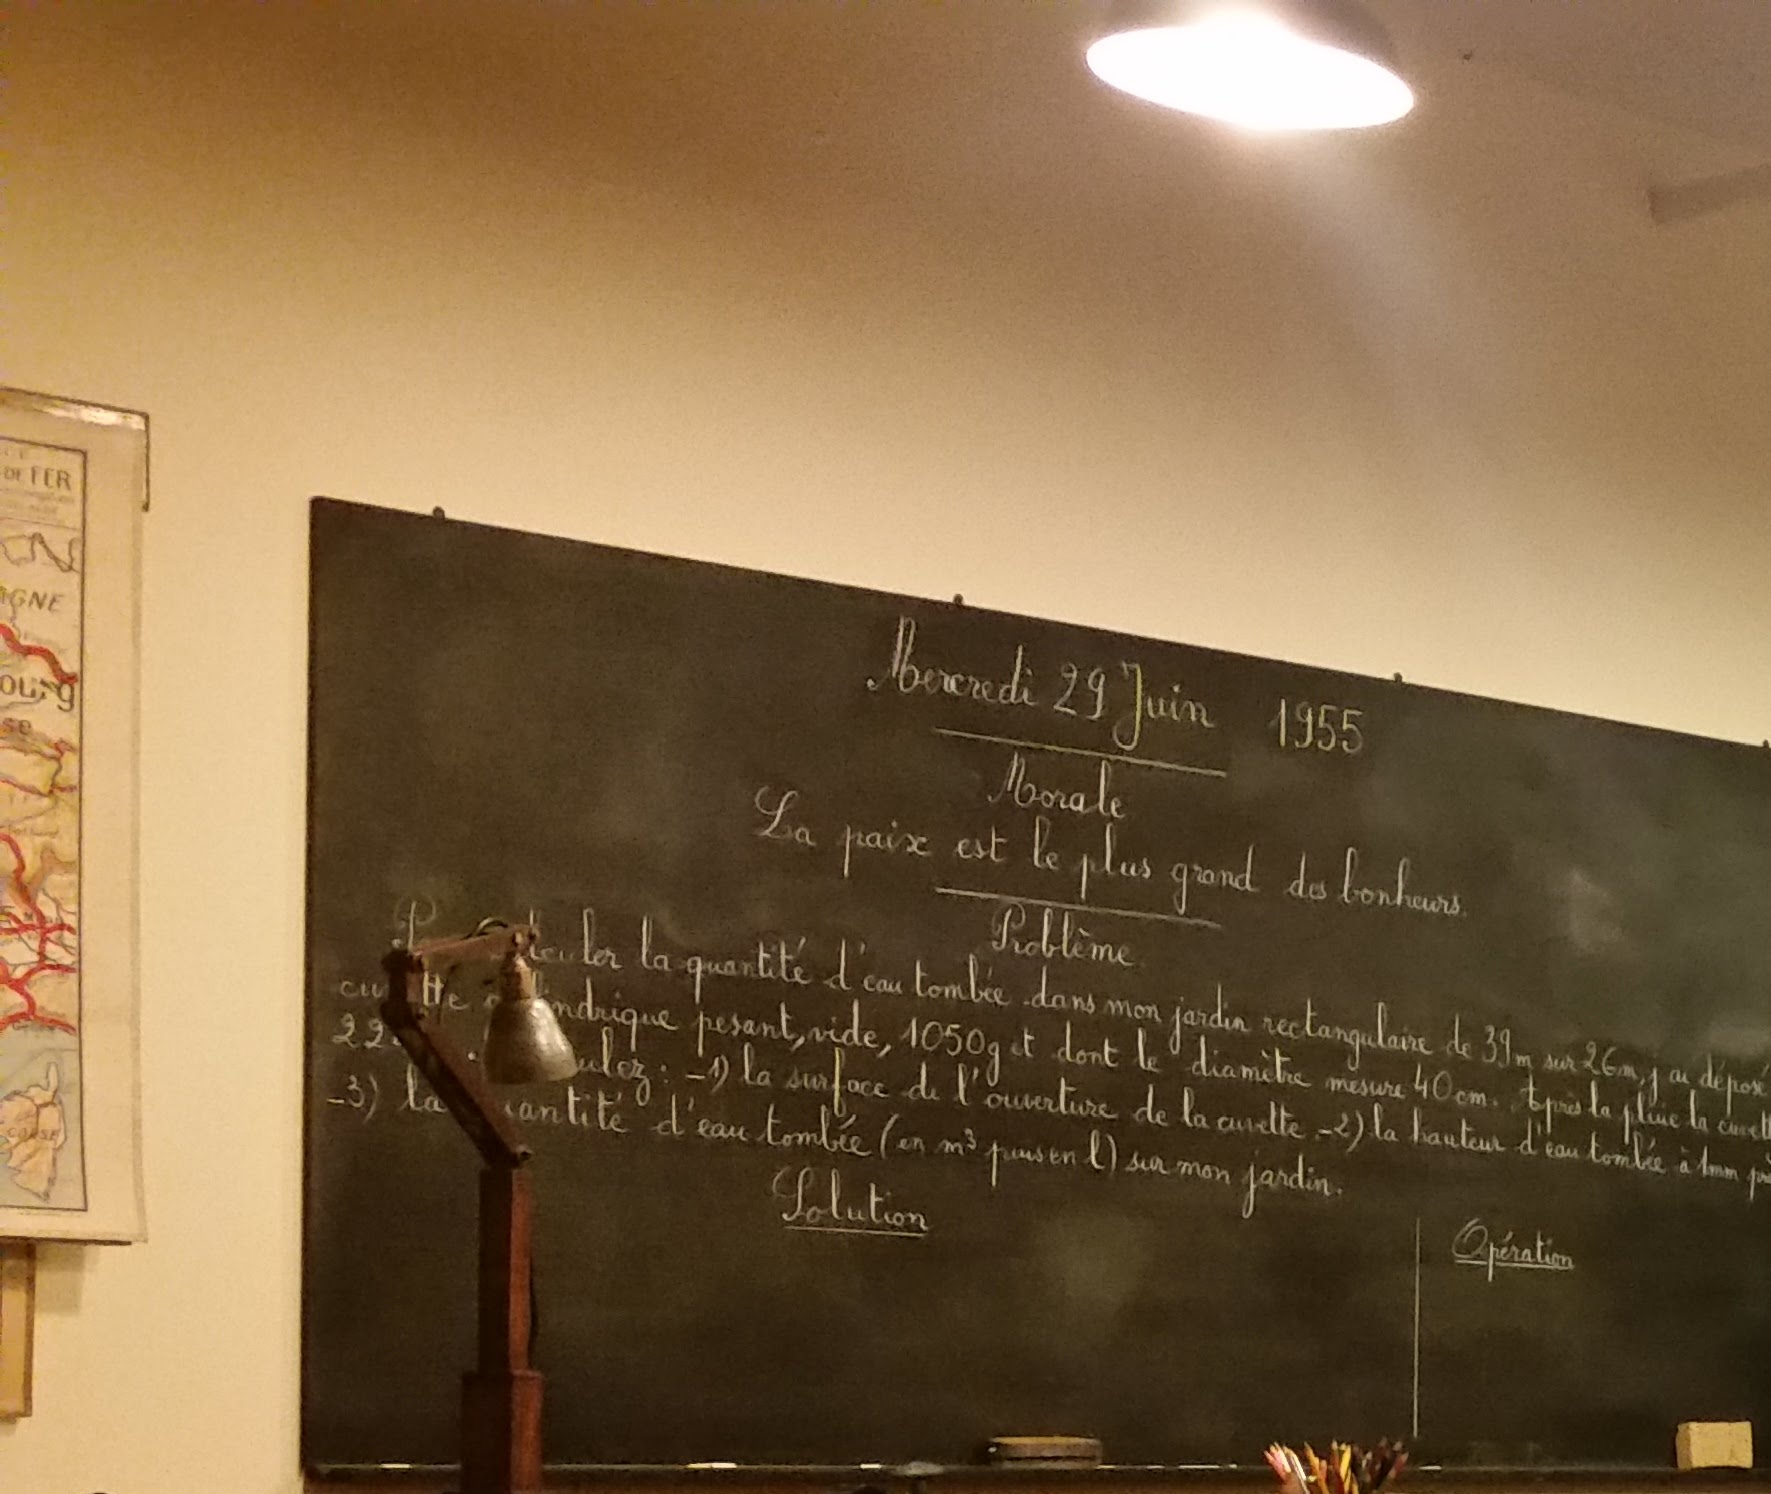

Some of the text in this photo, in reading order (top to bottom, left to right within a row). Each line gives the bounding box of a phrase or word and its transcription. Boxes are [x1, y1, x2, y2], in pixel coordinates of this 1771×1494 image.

[866, 616, 1364, 755] Mercredi 29 Juin 1955
[988, 752, 1126, 818] Morale
[754, 785, 818, 846] La
[840, 821, 931, 878] paix
[957, 826, 1006, 862] est
[1034, 815, 1060, 870] le
[1073, 823, 1151, 900] plus
[1169, 844, 1260, 915] grand
[1284, 852, 1328, 901] des
[641, 914, 673, 972] la
[686, 937, 812, 1004] quantité
[824, 938, 902, 995] d'eau
[915, 954, 1010, 1005] tombée
[1024, 965, 1096, 1013] dans
[1106, 998, 1161, 1024] mon
[1169, 983, 1249, 1055] jardin
[1263, 998, 1433, 1071] rectangulaire
[1447, 1013, 1472, 1059] de
[1543, 1053, 1577, 1073] sur
[402, 1062, 448, 1113] la
[653, 1094, 748, 1142] d'eau
[760, 1103, 873, 1157] tombée
[988, 1140, 1045, 1188] puis
[1050, 1148, 1077, 1166] en
[1125, 1151, 1169, 1176] sur
[1177, 1158, 1231, 1185] mon
[744, 1042, 771, 1087] la
[786, 1047, 890, 1117] surface
[909, 1061, 939, 1101] de
[1134, 1084, 1168, 1127] de
[1183, 1087, 1208, 1129] la
[1217, 1101, 1304, 1139] cuvette
[1374, 1102, 1398, 1142] la
[1412, 1106, 1505, 1151] hauteur
[1590, 1131, 1666, 1176] tombée
[1011, 1027, 1036, 1057] et
[1056, 1020, 1118, 1068] dont
[1135, 1027, 1162, 1073] le
[1189, 1035, 1311, 1087] diamètre
[1327, 1076, 1405, 1100] mesure
[1590, 1080, 1612, 1118] la
[1622, 1090, 1680, 1145] pluie
[1690, 1089, 1709, 1133] la
[772, 1165, 929, 1231] Solution
[1452, 1217, 1575, 1282] Opération
